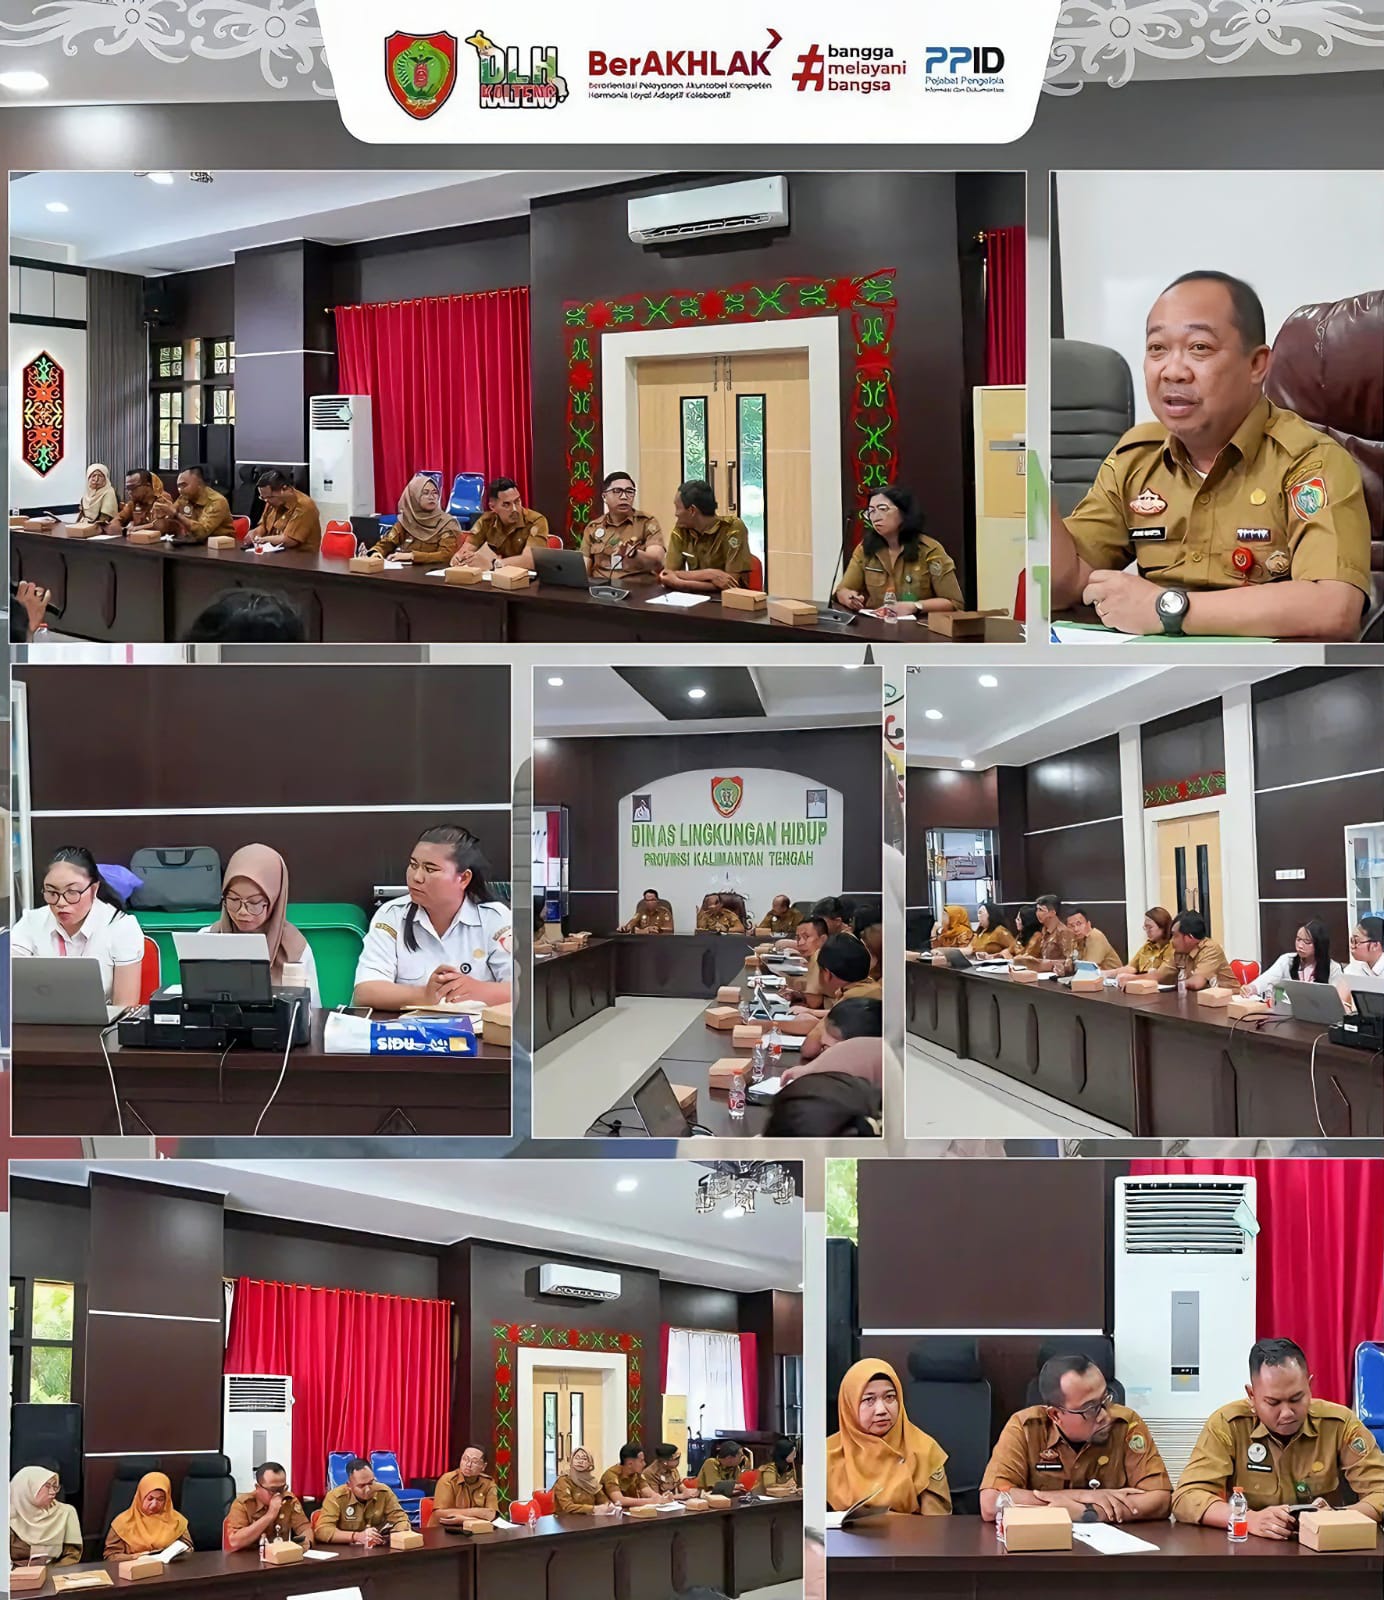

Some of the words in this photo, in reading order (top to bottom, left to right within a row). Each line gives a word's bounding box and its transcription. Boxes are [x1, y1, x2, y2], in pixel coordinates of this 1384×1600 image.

[631, 823, 676, 848] DINAS
[680, 820, 777, 847] LINGKUNGAN
[781, 820, 829, 846] HIDUP
[643, 852, 690, 867] PROVINSI
[693, 851, 764, 867] KALIMANTAN
[769, 850, 814, 867] TENGAH
